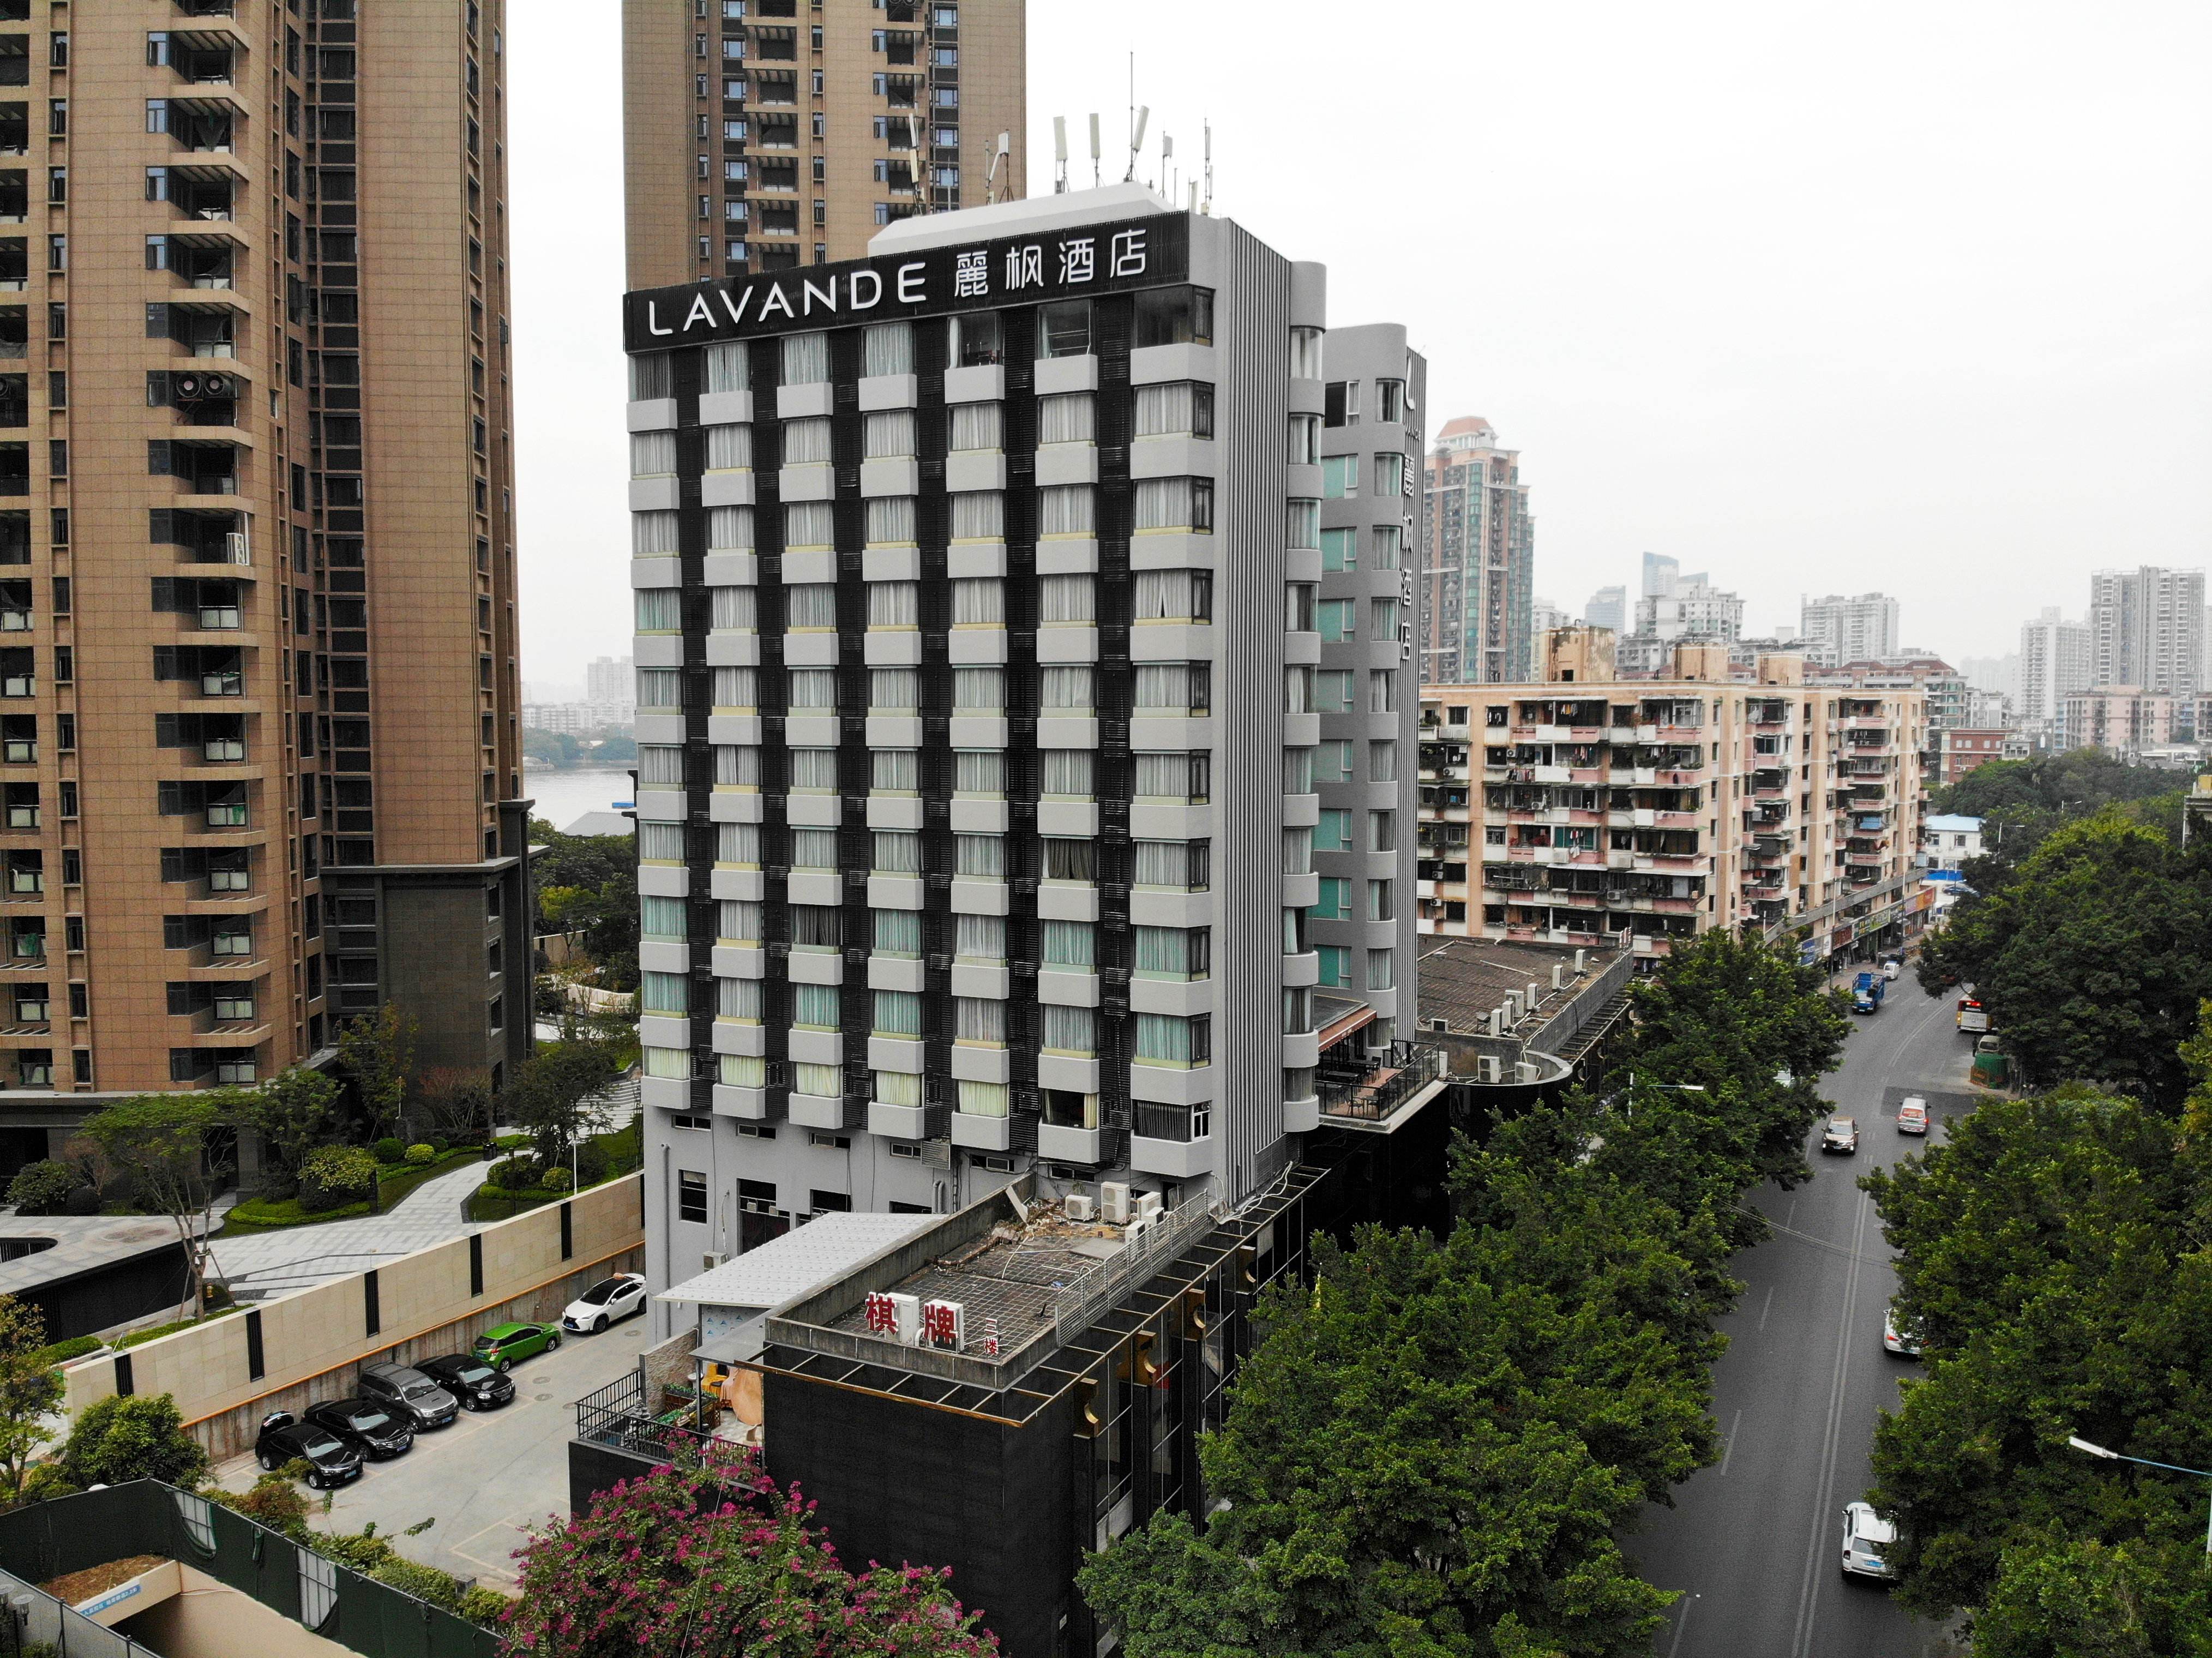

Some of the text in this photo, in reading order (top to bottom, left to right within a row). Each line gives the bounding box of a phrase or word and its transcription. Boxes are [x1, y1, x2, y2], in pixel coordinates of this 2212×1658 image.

[954, 228, 1147, 298] 麗枫酒店
[649, 262, 926, 336] LAVANDE
[865, 1292, 958, 1344] 棋牌
[984, 1318, 999, 1356] 三楼
